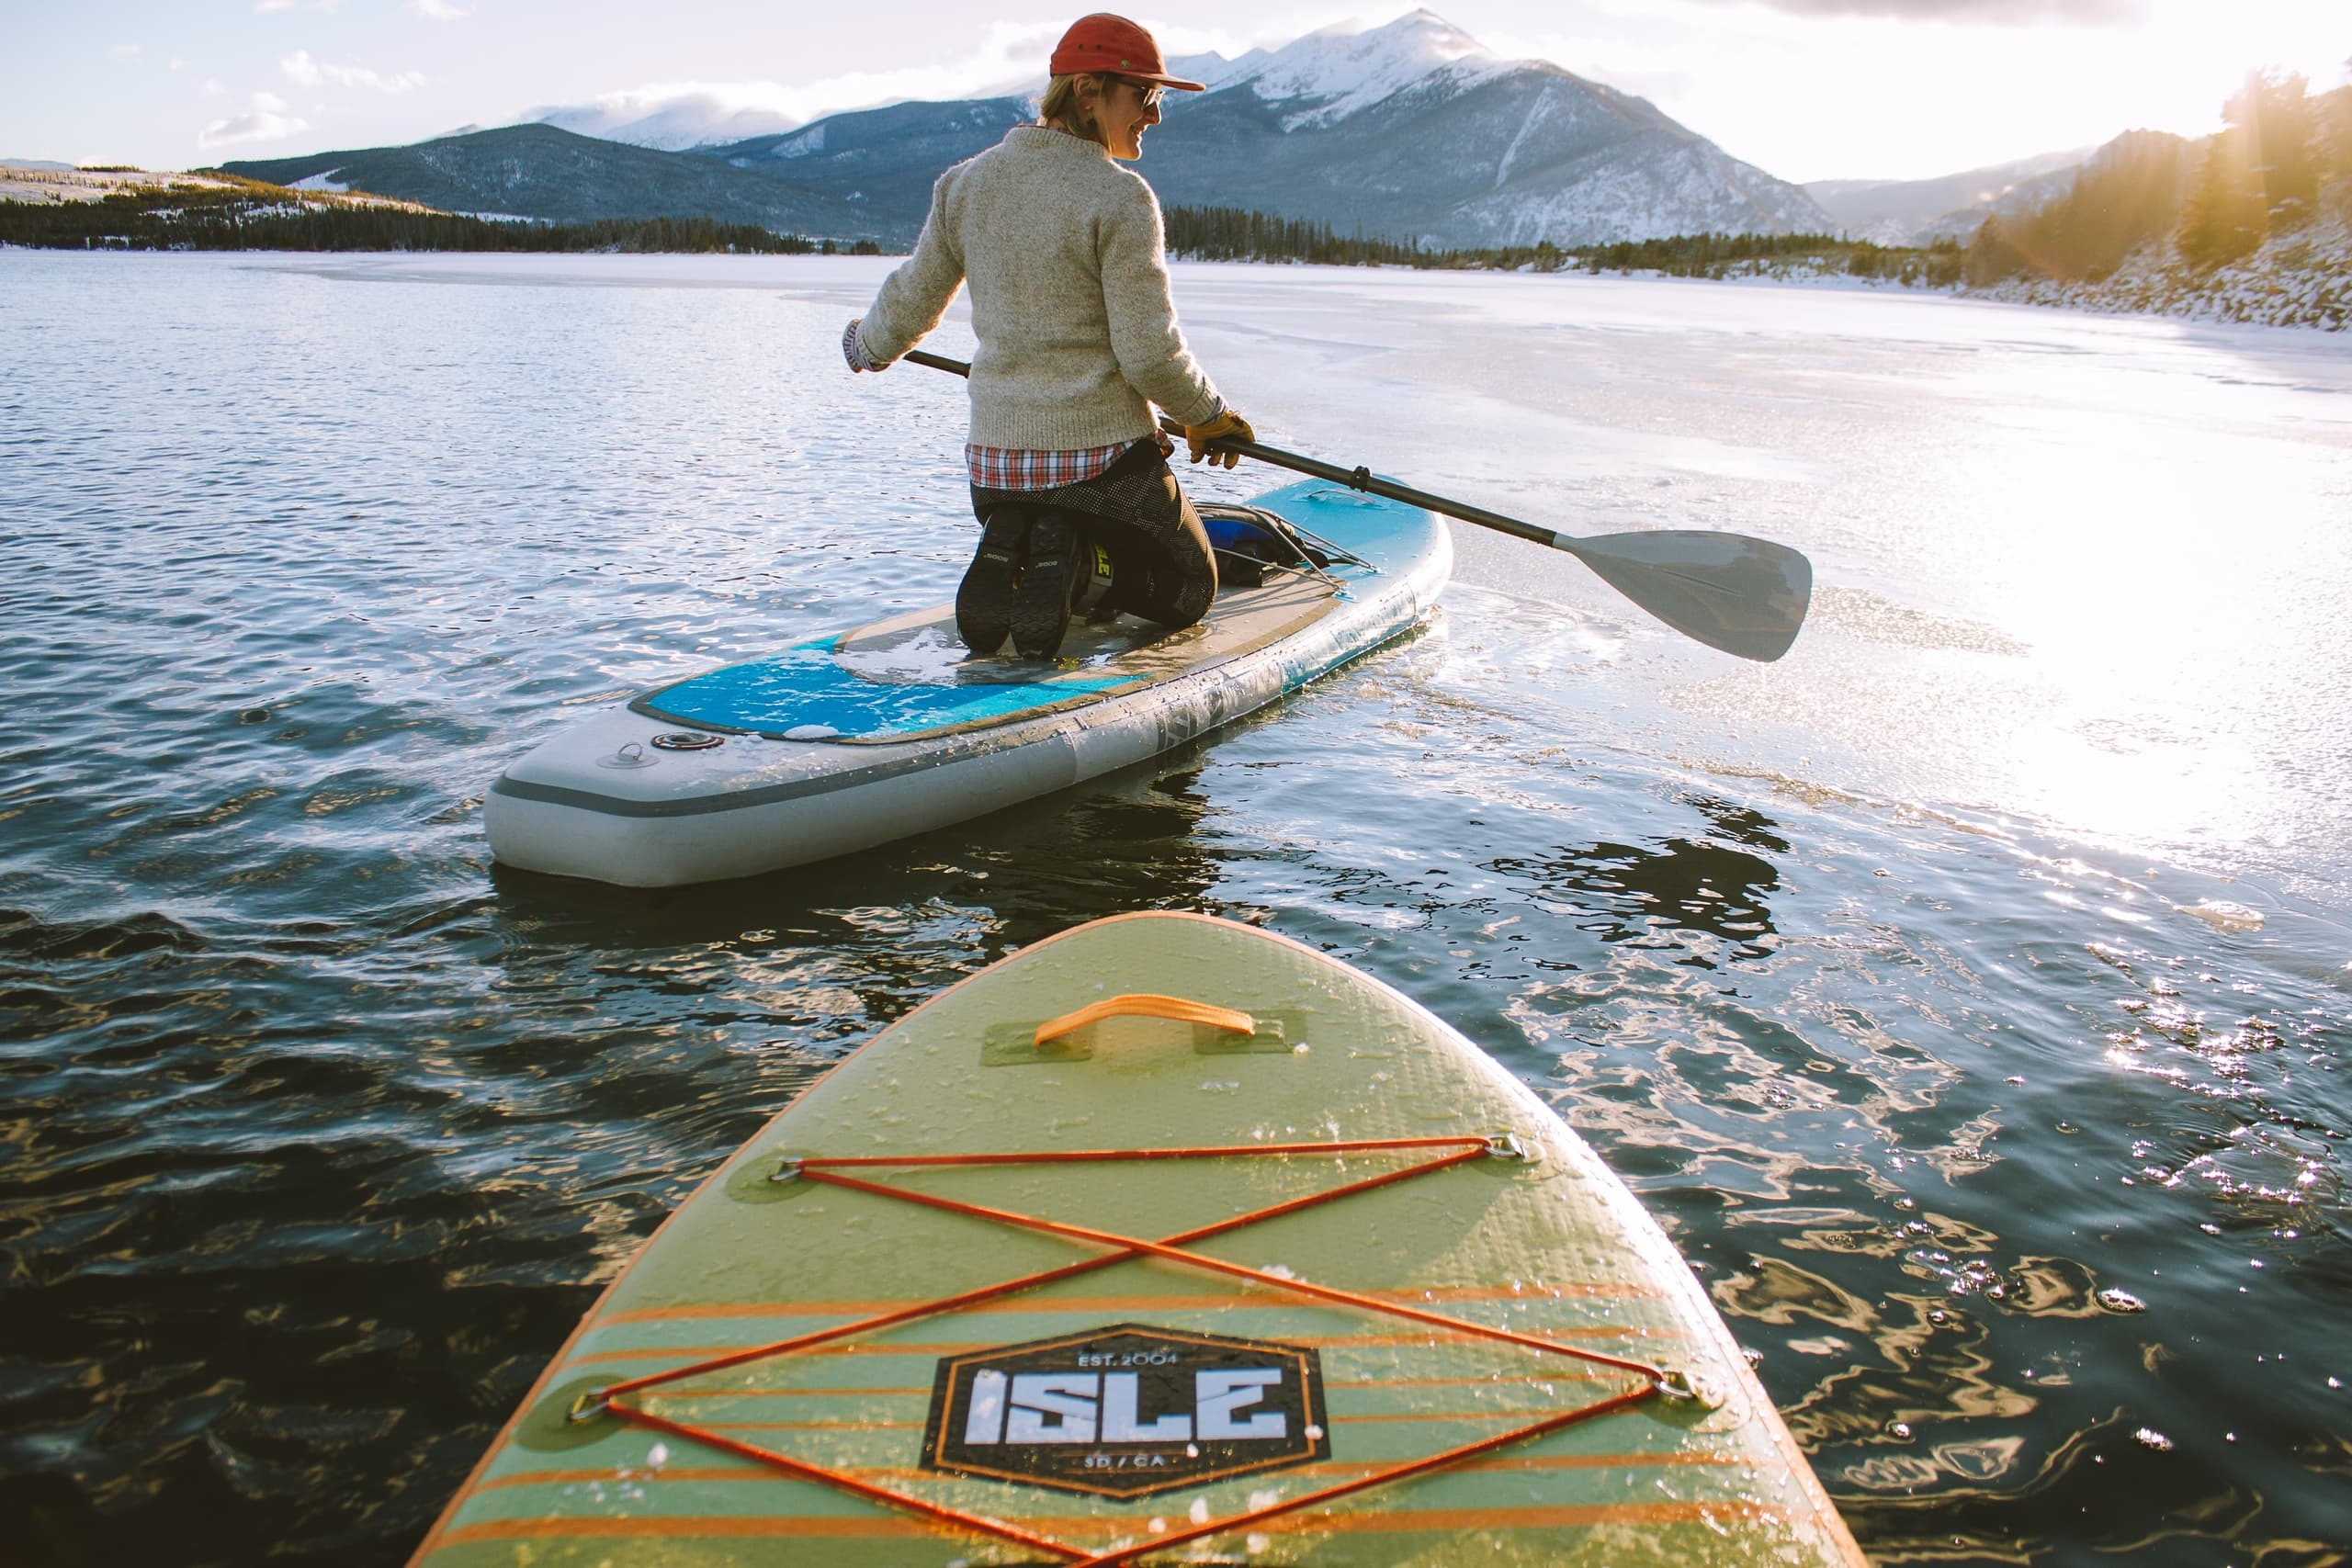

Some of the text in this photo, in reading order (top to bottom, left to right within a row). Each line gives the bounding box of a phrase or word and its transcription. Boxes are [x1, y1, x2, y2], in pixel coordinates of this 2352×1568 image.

[1079, 1353, 1177, 1367] EST. 2004
[964, 1368, 1286, 1444] ISLE
[1084, 1454, 1112, 1468] SD
[1133, 1454, 1166, 1467] CA
